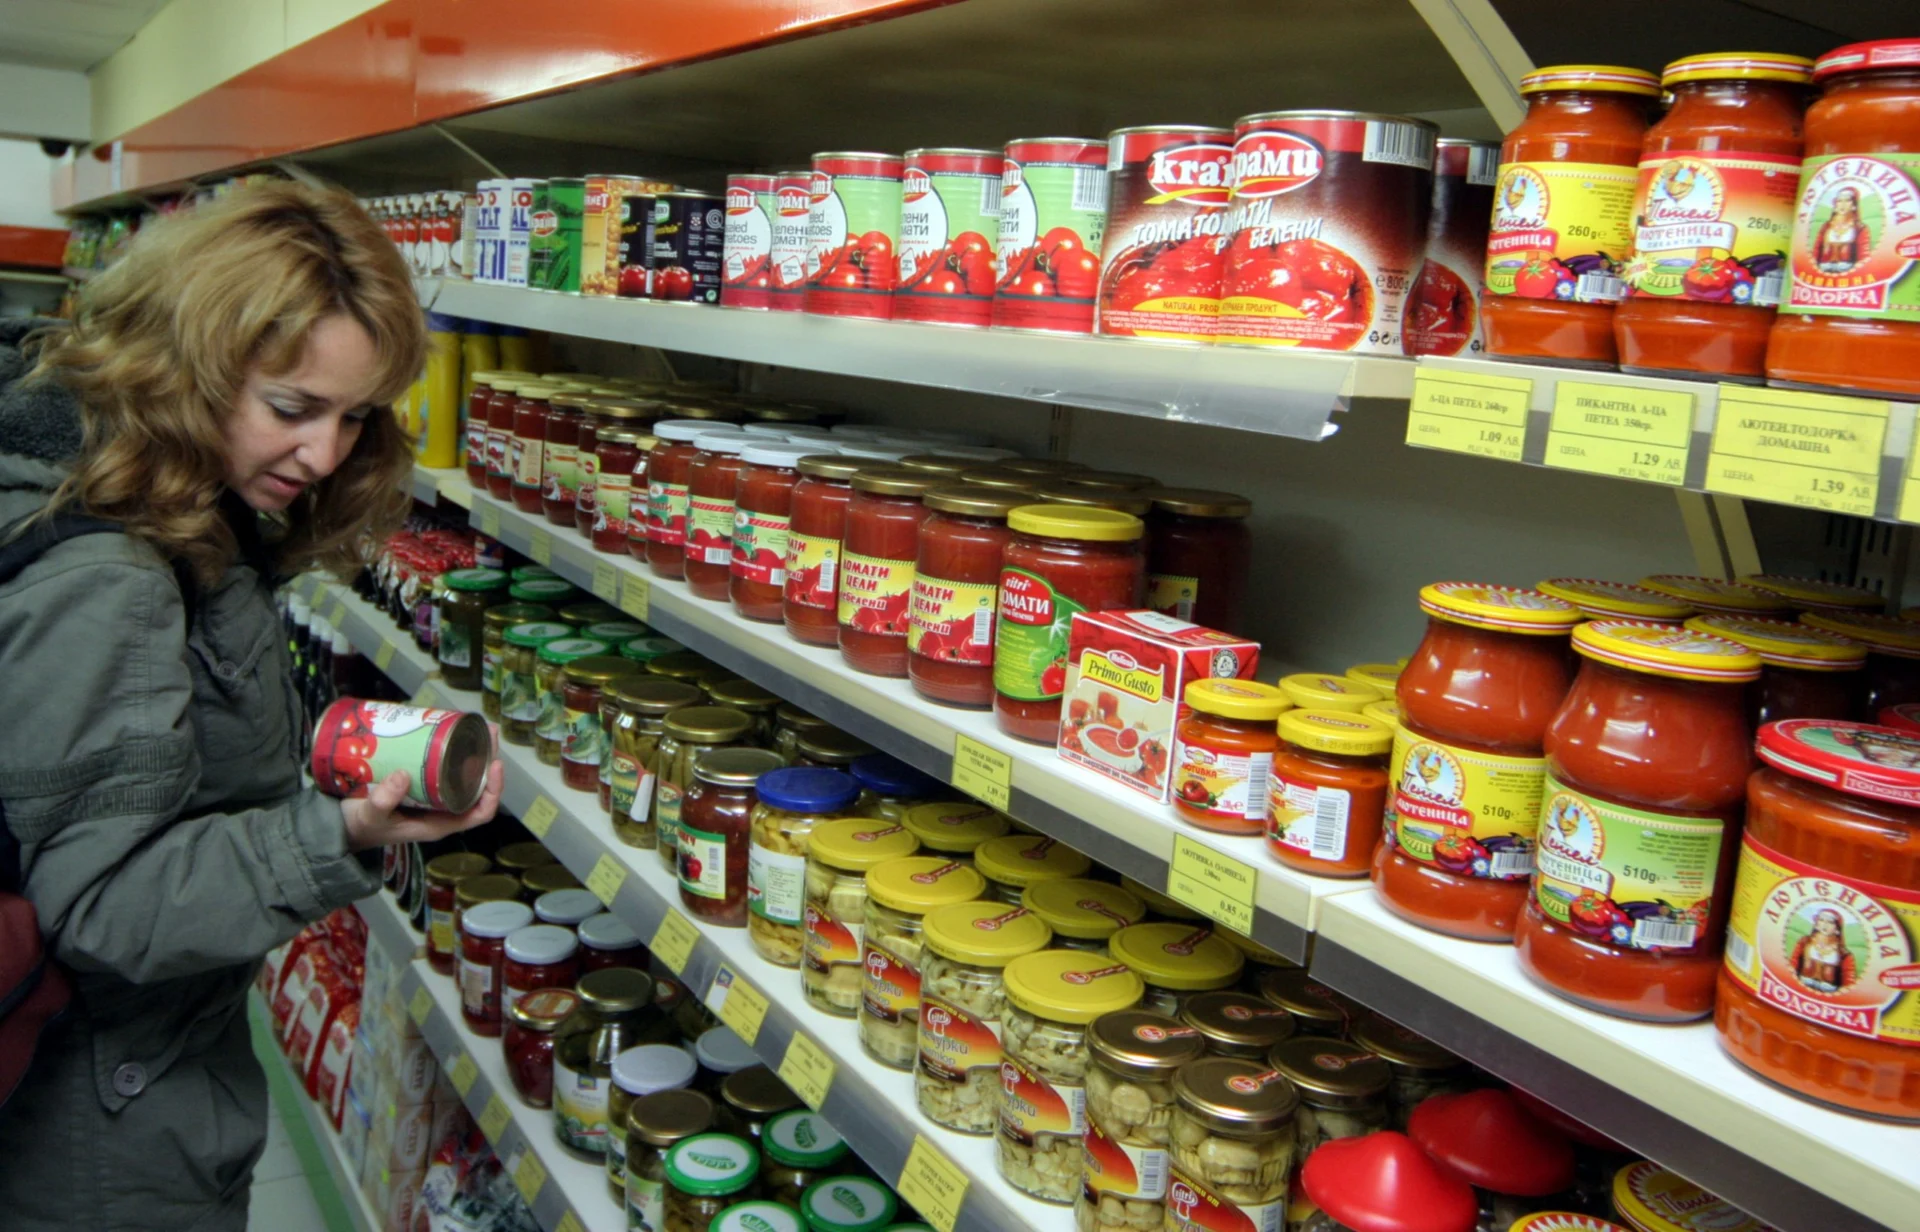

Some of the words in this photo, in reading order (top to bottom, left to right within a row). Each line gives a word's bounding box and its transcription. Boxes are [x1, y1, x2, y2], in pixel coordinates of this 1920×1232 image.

[1250, 217, 1322, 249] БЕЛЕНИ
[1793, 284, 1879, 306] ТОДОРКА
[1162, 300, 1196, 312] NATURAL
[1576, 397, 1637, 413] ПИКАНТНА
[1584, 413, 1620, 427] ПЕТЕЛ
[1480, 430, 1502, 442] 1.09
[1756, 435, 1832, 454] ДОМАШНА
[1632, 451, 1660, 466] 1.29
[1811, 478, 1845, 495] 1.39
[1088, 659, 1122, 684] Primo
[1124, 672, 1155, 696] Gusto
[1482, 804, 1511, 820] 510g
[1622, 864, 1657, 885] 510g
[1220, 899, 1237, 915] 0.85
[1765, 879, 1901, 959] ЛЮТЕНИЦА
[1763, 976, 1870, 1029] ТОДОРКА
